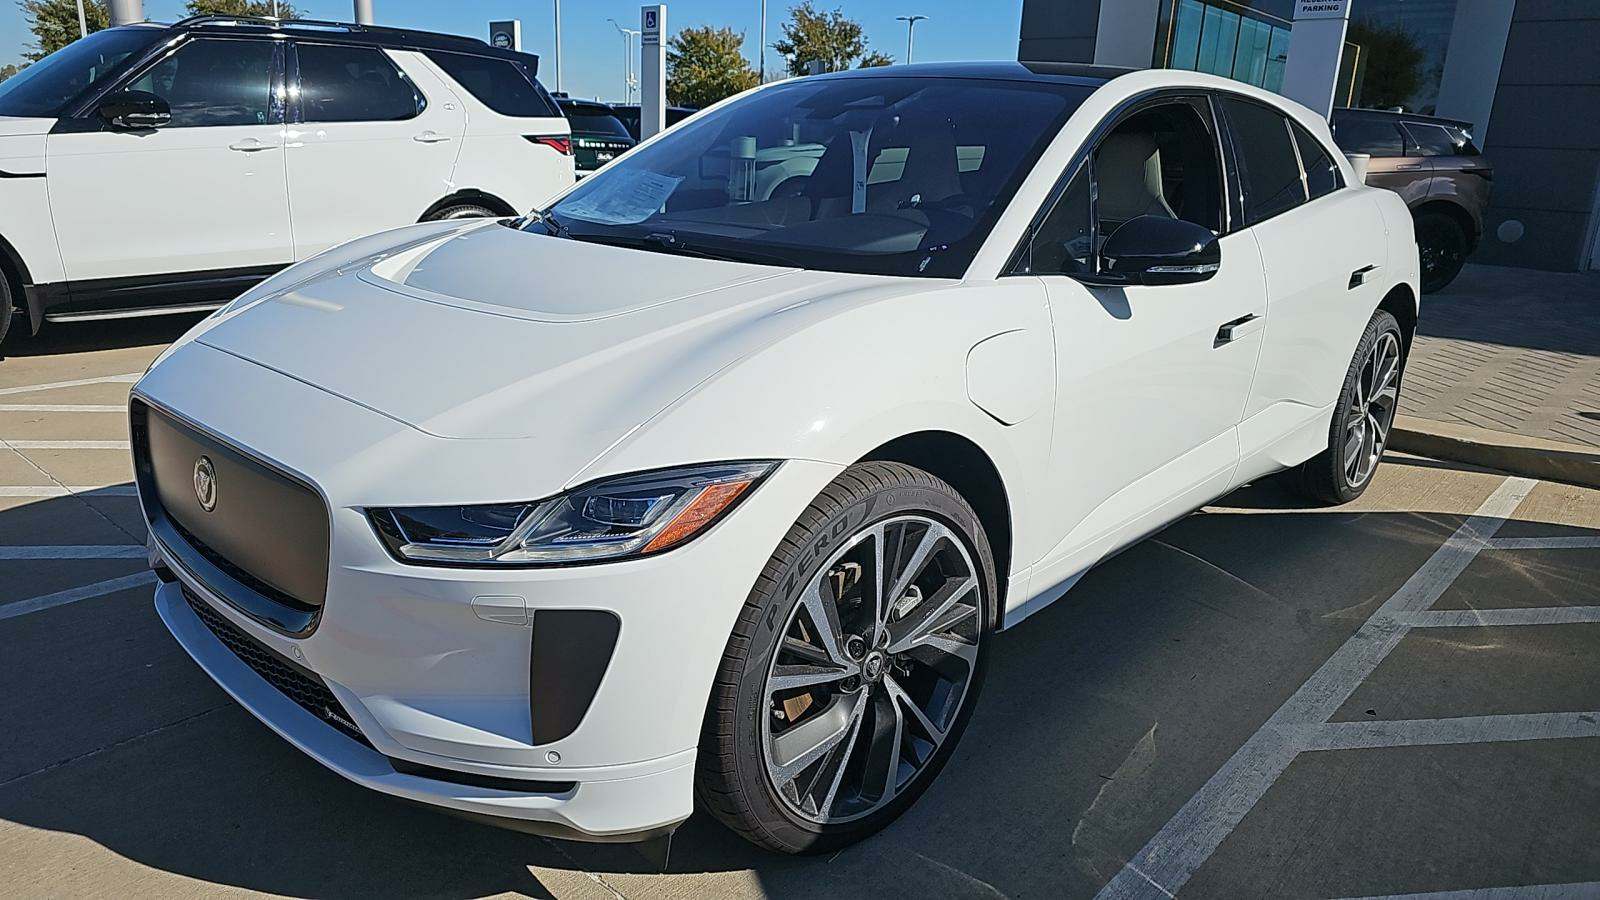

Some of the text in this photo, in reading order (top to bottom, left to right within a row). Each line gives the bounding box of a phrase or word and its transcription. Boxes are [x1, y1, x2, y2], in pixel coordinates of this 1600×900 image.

[1302, 4, 1340, 12] PARKING
[765, 514, 848, 632] P ZERO
